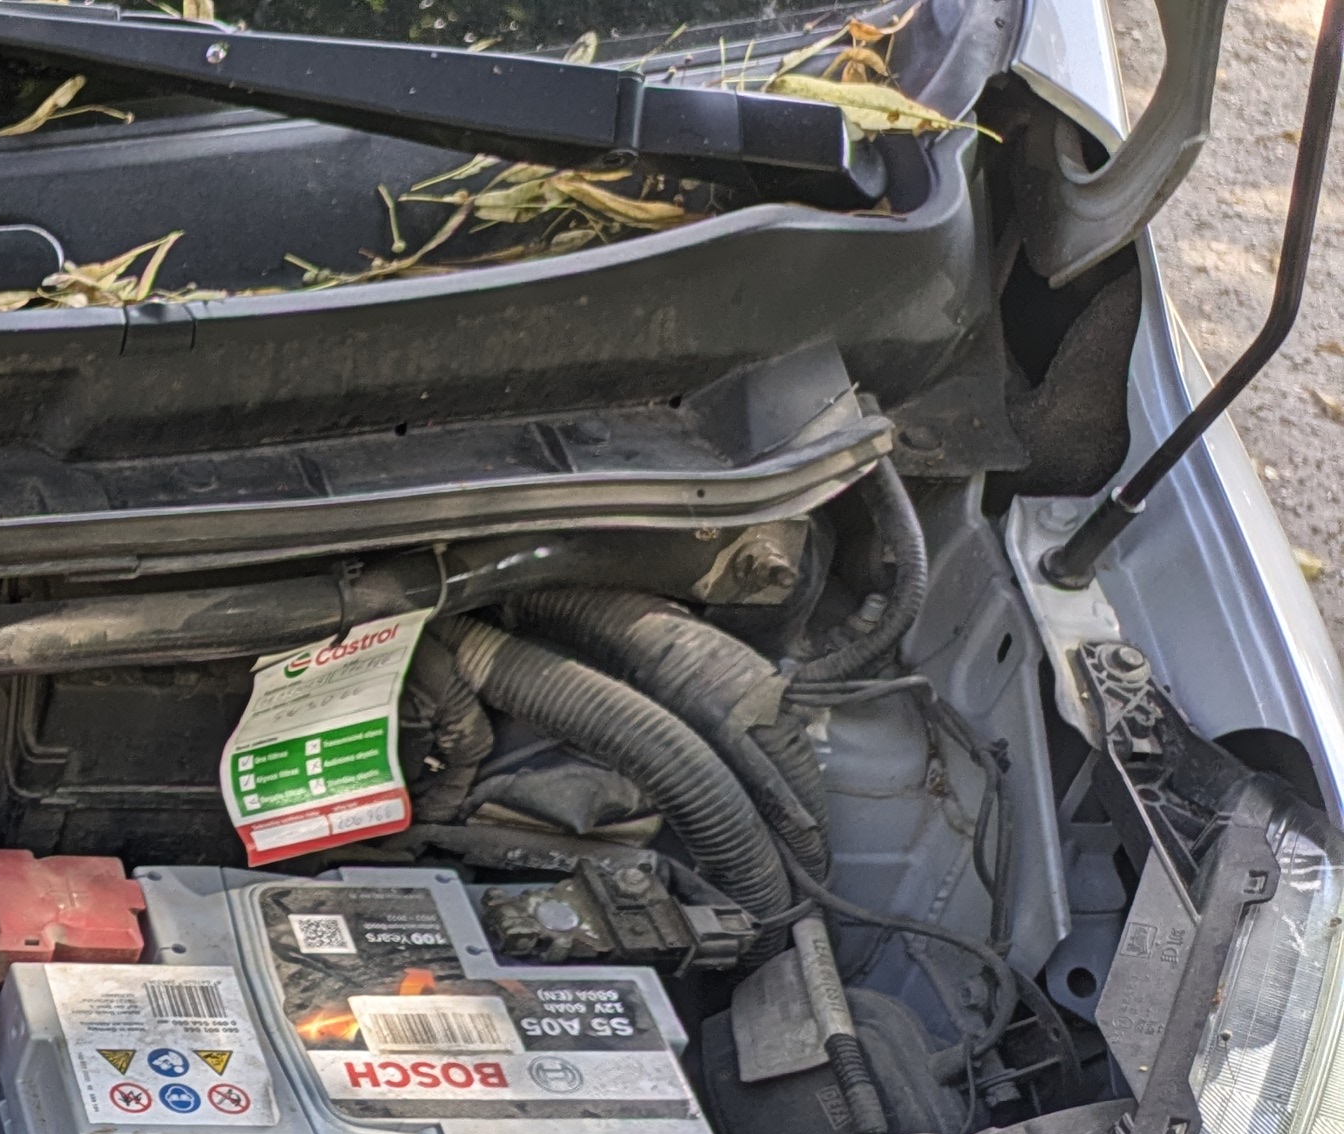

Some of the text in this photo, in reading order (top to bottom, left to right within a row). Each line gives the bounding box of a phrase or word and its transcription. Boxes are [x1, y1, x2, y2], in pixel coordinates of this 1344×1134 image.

[314, 623, 401, 666] Castrol
[537, 989, 574, 1001] (EN)
[543, 1002, 625, 1013] 12V 60Ah
[520, 1017, 634, 1036] S5 A05
[344, 1061, 510, 1089] BOSCH
